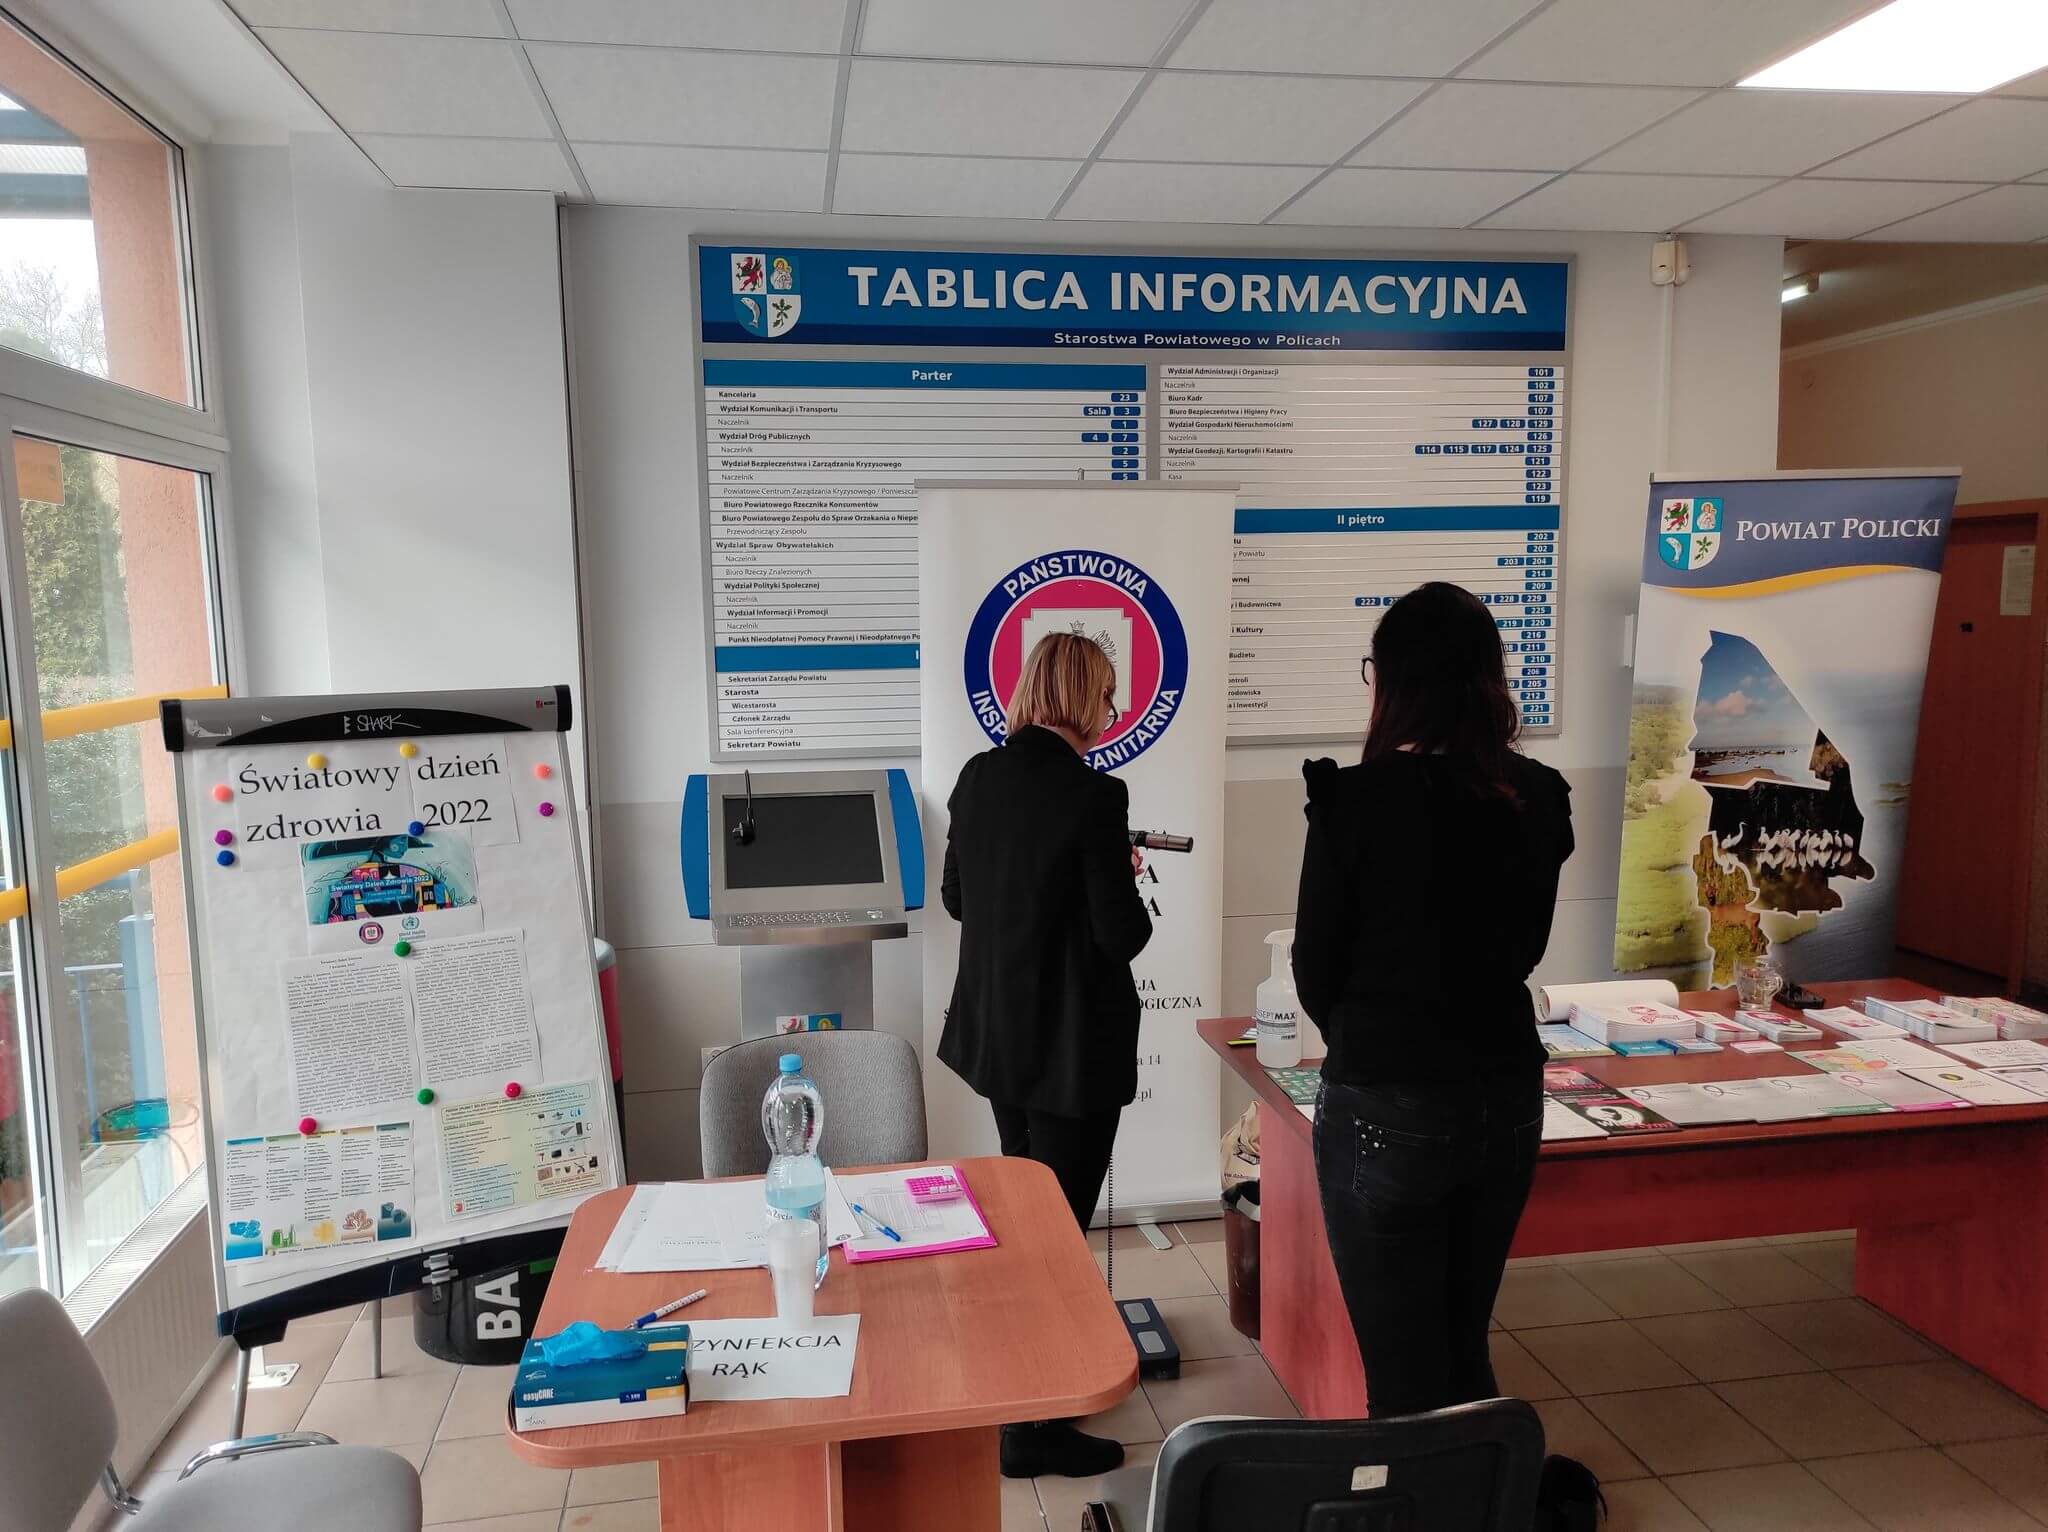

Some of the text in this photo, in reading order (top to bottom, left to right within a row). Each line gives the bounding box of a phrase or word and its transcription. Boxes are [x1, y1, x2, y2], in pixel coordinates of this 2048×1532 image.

[848, 266, 1528, 320] TABLICA INFORMACYJNA
[1054, 331, 1341, 348] Starostwa Powiatowego w Policach
[912, 369, 953, 382] Parter
[1195, 368, 1238, 376] Administracji
[720, 405, 839, 415] Wydział Komunikacji Transportu
[1087, 407, 1107, 415] Sala
[1189, 408, 1240, 416] Bezpieczeństwa
[1244, 408, 1268, 416] Higieny
[1195, 421, 1233, 429] Gospodarki
[749, 433, 767, 441] Dróg
[769, 433, 811, 441] Publicznych
[1194, 447, 1225, 455] Geodezji,
[1226, 447, 1262, 455] Kartografii
[751, 461, 807, 469] Bezpieczeństwa
[813, 461, 854, 469] Zarządzania
[856, 461, 902, 469] Kryzysowego
[743, 515, 790, 523] Powiatowego
[792, 515, 820, 523] Zespołu
[832, 515, 853, 523] Spraw
[1337, 515, 1385, 526] II piętro
[726, 528, 807, 537] Przewodniczący Zespołu
[1735, 518, 1941, 541] POWIAT POLICKI
[716, 542, 747, 550] Wydział
[749, 542, 773, 550] Spraw
[745, 569, 767, 577] Rzeczy
[768, 568, 812, 576] Znalezionych
[1003, 554, 1148, 600] PAŃSTWOWA
[724, 582, 820, 590] Wydział Polityki Społecznej
[1531, 582, 1546, 590] 209
[1360, 598, 1376, 606] 222
[727, 609, 755, 617] Wydział
[757, 609, 792, 617] Informacji
[751, 635, 797, 643] Nieodpłatnej
[798, 635, 826, 643] Pomocy
[827, 634, 855, 642] Prawnej
[860, 634, 911, 642] Nieodpłatnego
[728, 675, 768, 683] Sekretariat
[768, 675, 797, 683] Zarządu
[1530, 704, 1543, 712] 221
[357, 714, 421, 731] SHARK
[732, 715, 760, 723] Członek
[727, 727, 793, 736] Sala konferencyjna
[727, 741, 765, 749] Sekretarz
[238, 753, 500, 795] Światowy dzień
[247, 799, 492, 842] zdrowia 2022
[331, 883, 363, 891] Światowy
[365, 880, 384, 888] Dzień
[386, 878, 413, 886] Zdrowia
[693, 1335, 841, 1351] ZYNFEKCJA
[712, 1362, 768, 1378] RĄK
[523, 1388, 554, 1402] easyCARE
